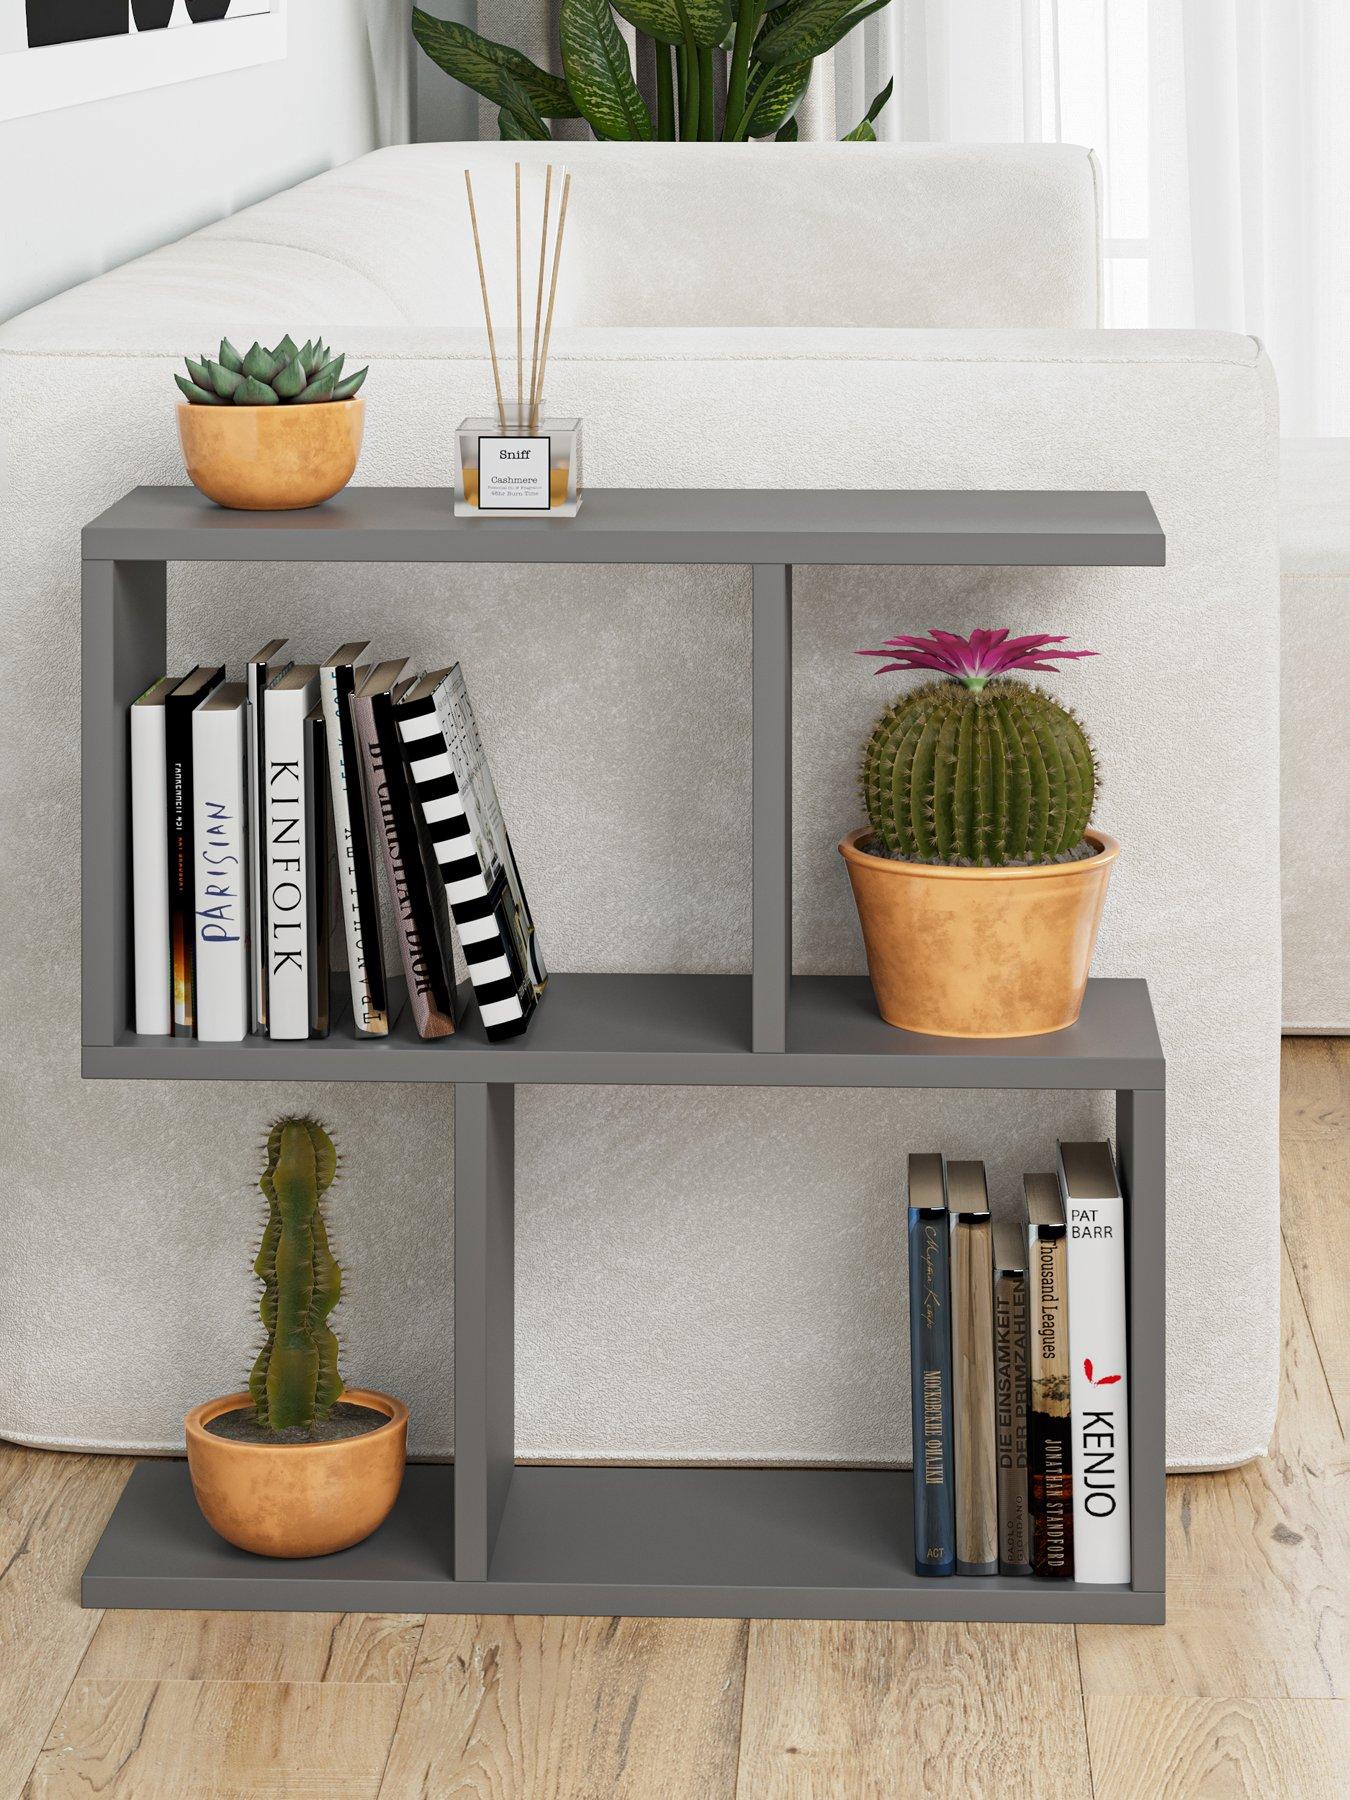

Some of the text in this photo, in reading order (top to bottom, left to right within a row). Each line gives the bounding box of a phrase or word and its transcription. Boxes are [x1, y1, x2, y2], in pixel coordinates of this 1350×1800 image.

[491, 475, 538, 484] Cashmere
[499, 449, 531, 460] Sniff
[196, 802, 240, 941] PARISIAN
[270, 760, 303, 976] KINFOLK
[405, 930, 432, 996] DIOR
[1071, 1209, 1098, 1222] PAT
[1071, 1226, 1113, 1239] BARR
[1038, 1239, 1059, 1359] Thousand Leagues
[923, 1370, 944, 1484] МОСКОВСКИЕ ФИАЛКИ
[997, 1296, 1013, 1469] DIE EINSAMKEIT
[1013, 1279, 1028, 1469] DER PRIMZAHLEN
[1044, 1439, 1065, 1567] JONATHAN STANDFORD
[1082, 1411, 1117, 1518] KENJO
